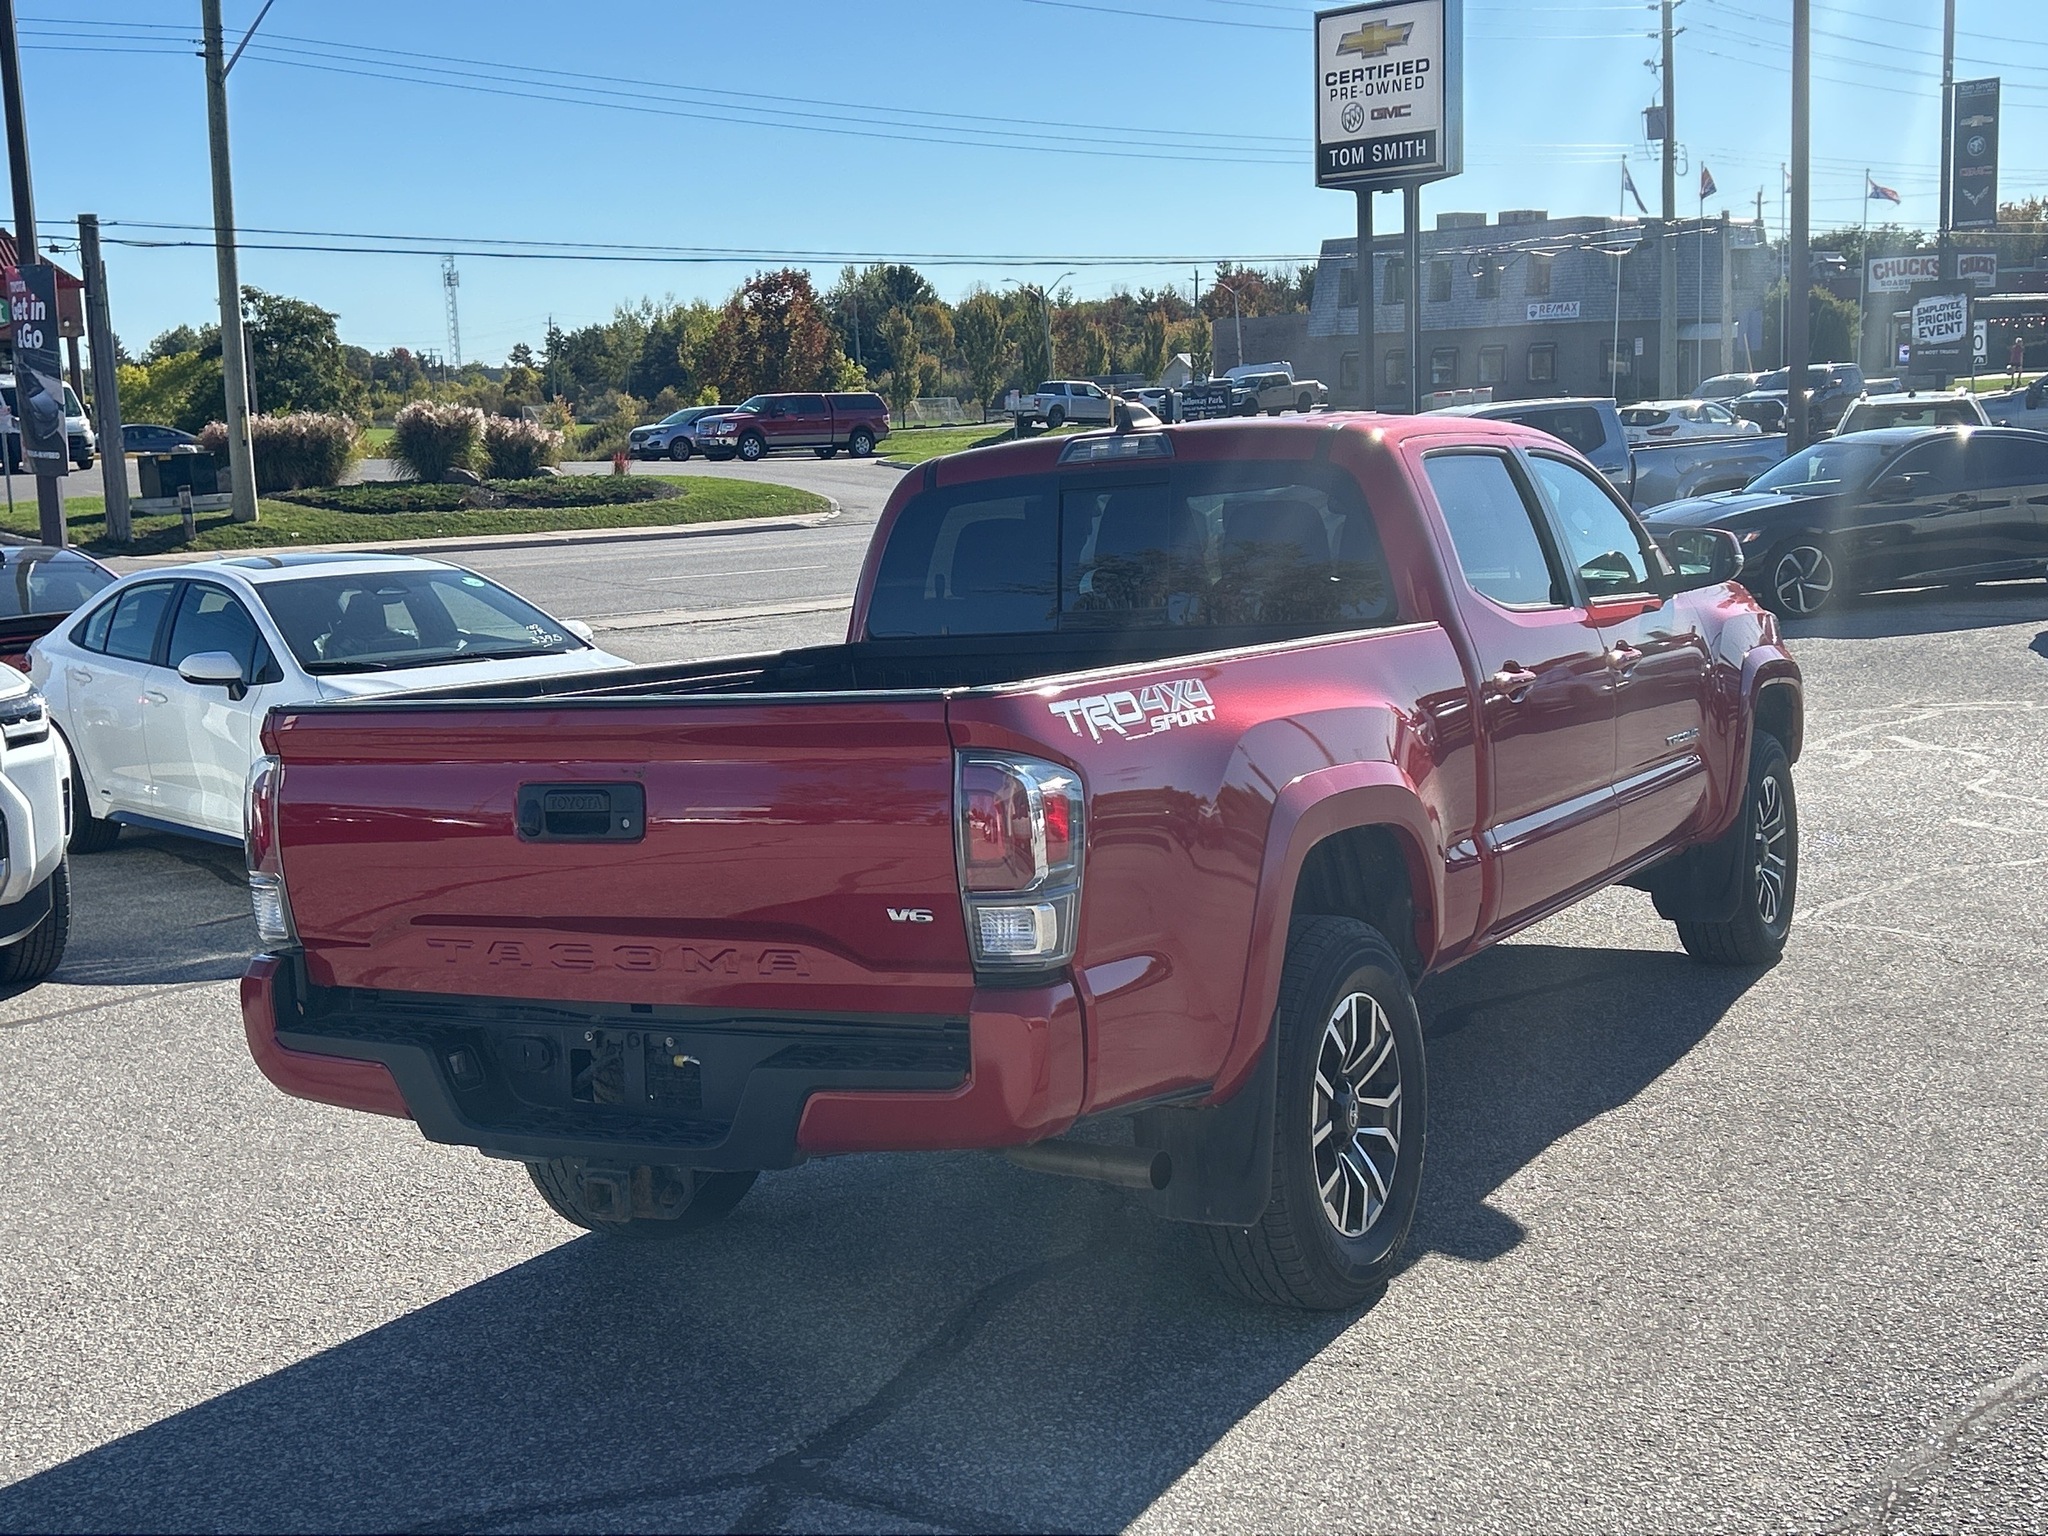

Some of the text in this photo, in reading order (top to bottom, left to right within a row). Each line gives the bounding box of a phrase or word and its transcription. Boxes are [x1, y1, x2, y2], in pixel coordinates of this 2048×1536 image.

[1325, 58, 1430, 87] CERTIFIED
[1330, 75, 1425, 102] PRE-OWNED
[1370, 104, 1412, 121] GMC
[1329, 139, 1427, 167] TOM SMITH
[12, 296, 29, 320] Get
[31, 294, 45, 320] in
[1539, 303, 1577, 313] RE/MAX
[1917, 301, 1961, 316] EMPLOYEE
[1918, 310, 1962, 326] PRICING
[1919, 321, 1963, 339] EVENT
[1208, 396, 1224, 405] Park
[1048, 691, 1147, 744] TRD
[1150, 705, 1216, 733] SPORT
[548, 795, 604, 810] TOYOTA
[886, 908, 934, 922] V6
[426, 937, 811, 978] TACOMA
